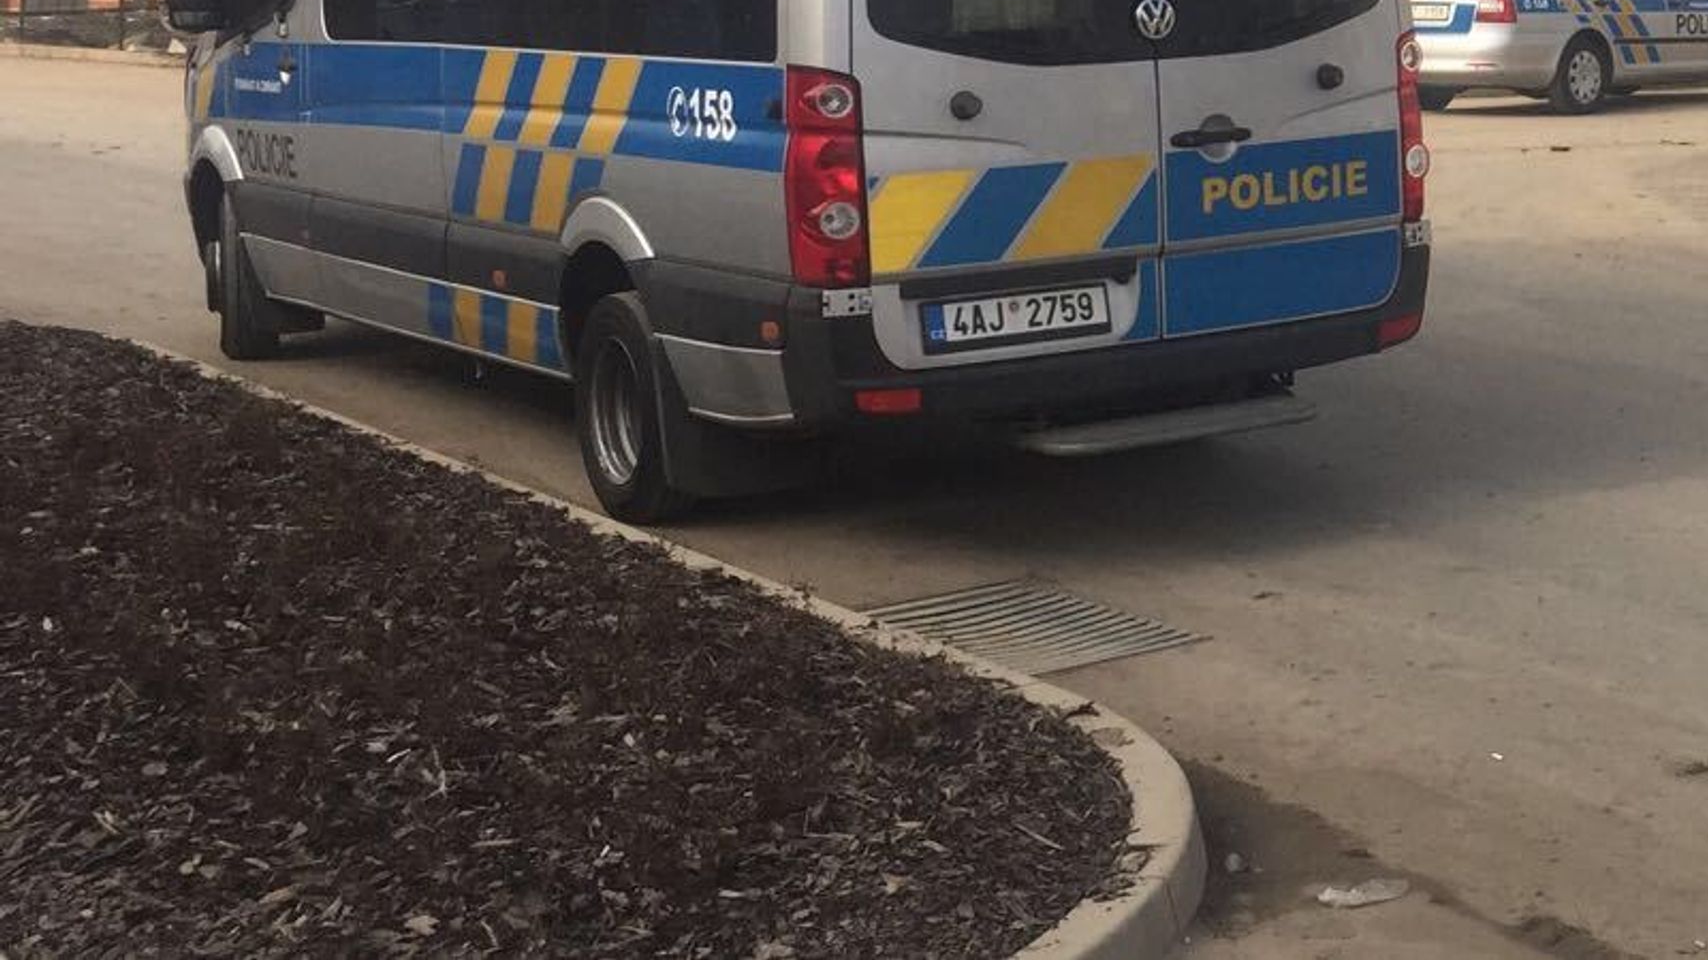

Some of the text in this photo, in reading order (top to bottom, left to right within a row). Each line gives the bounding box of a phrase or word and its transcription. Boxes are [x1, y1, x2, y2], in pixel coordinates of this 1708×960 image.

[690, 88, 737, 141] 158
[238, 129, 297, 178] POLICIE
[1202, 160, 1368, 214] POLICIE
[953, 292, 1094, 335] 4AJ 2759
